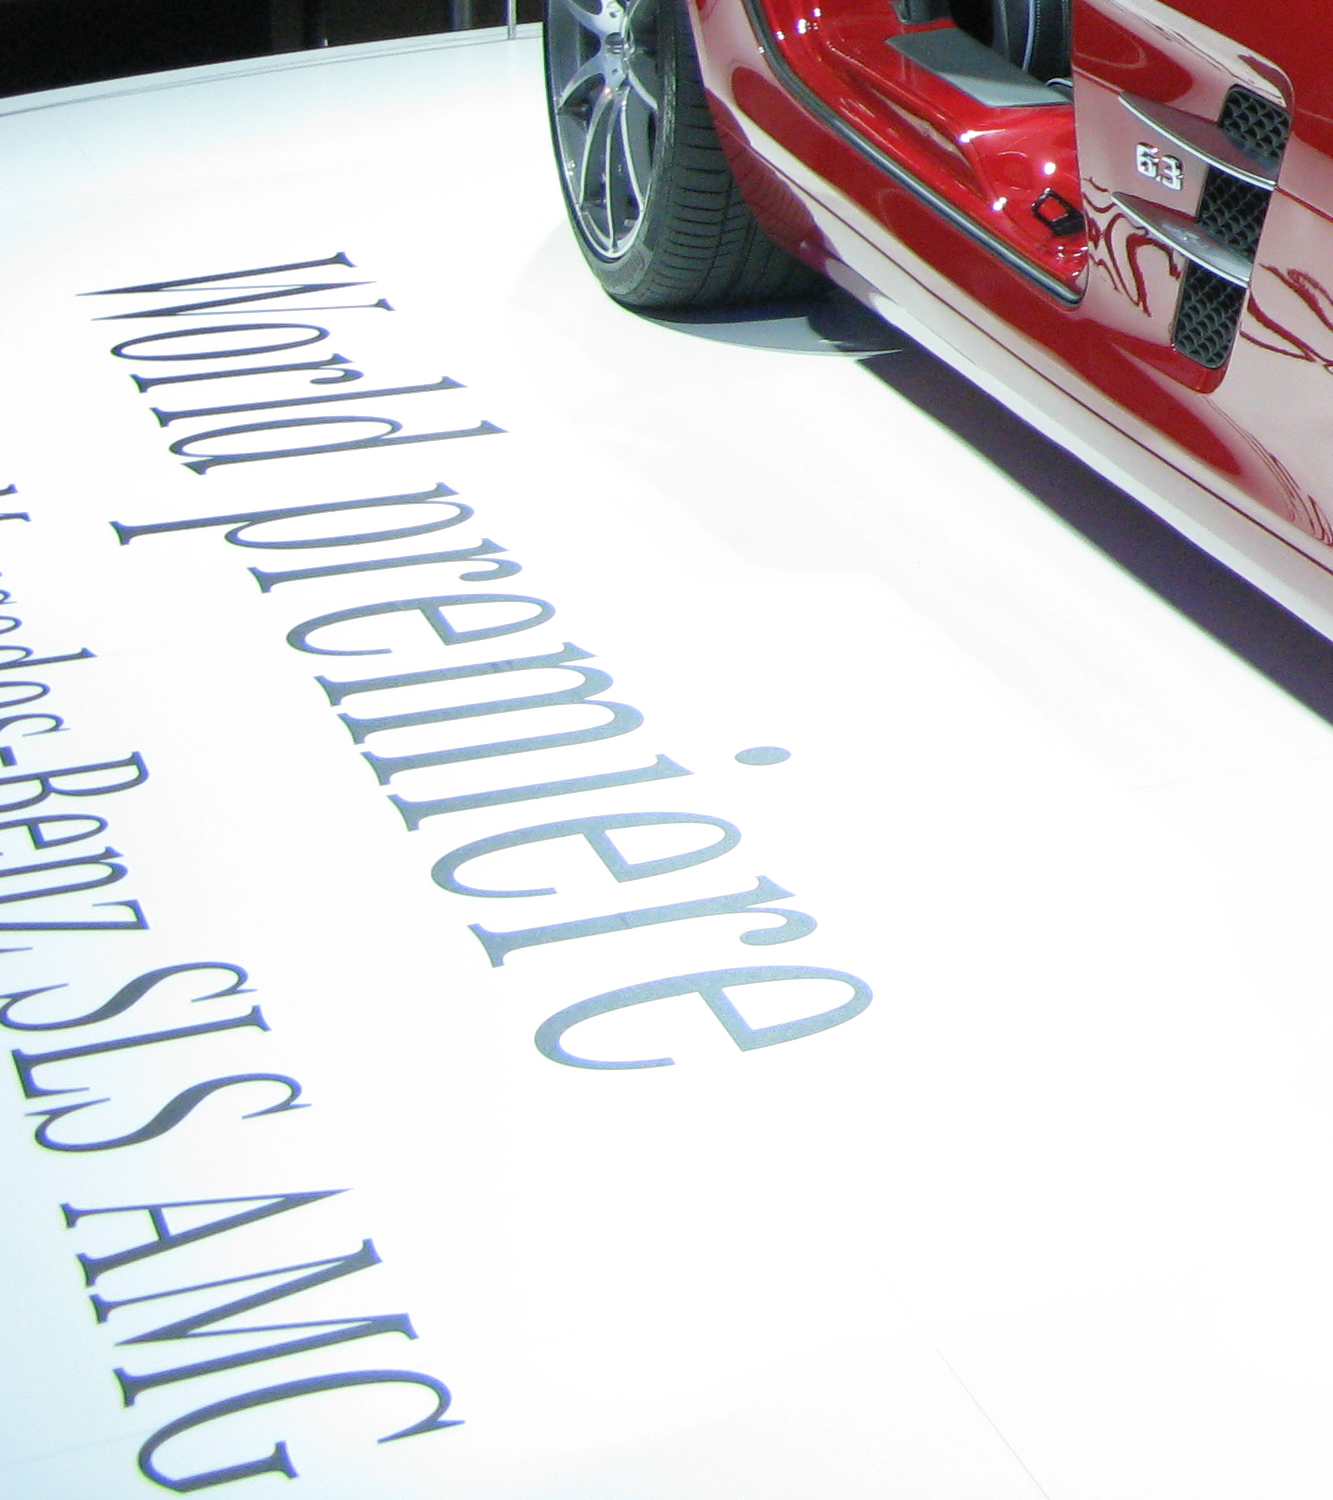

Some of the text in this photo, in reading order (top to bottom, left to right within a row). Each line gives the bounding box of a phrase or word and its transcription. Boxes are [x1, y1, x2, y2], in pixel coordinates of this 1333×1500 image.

[75, 251, 874, 1071] World premiere
[0, 961, 312, 1154] SLS
[59, 1187, 466, 1494] AMG
